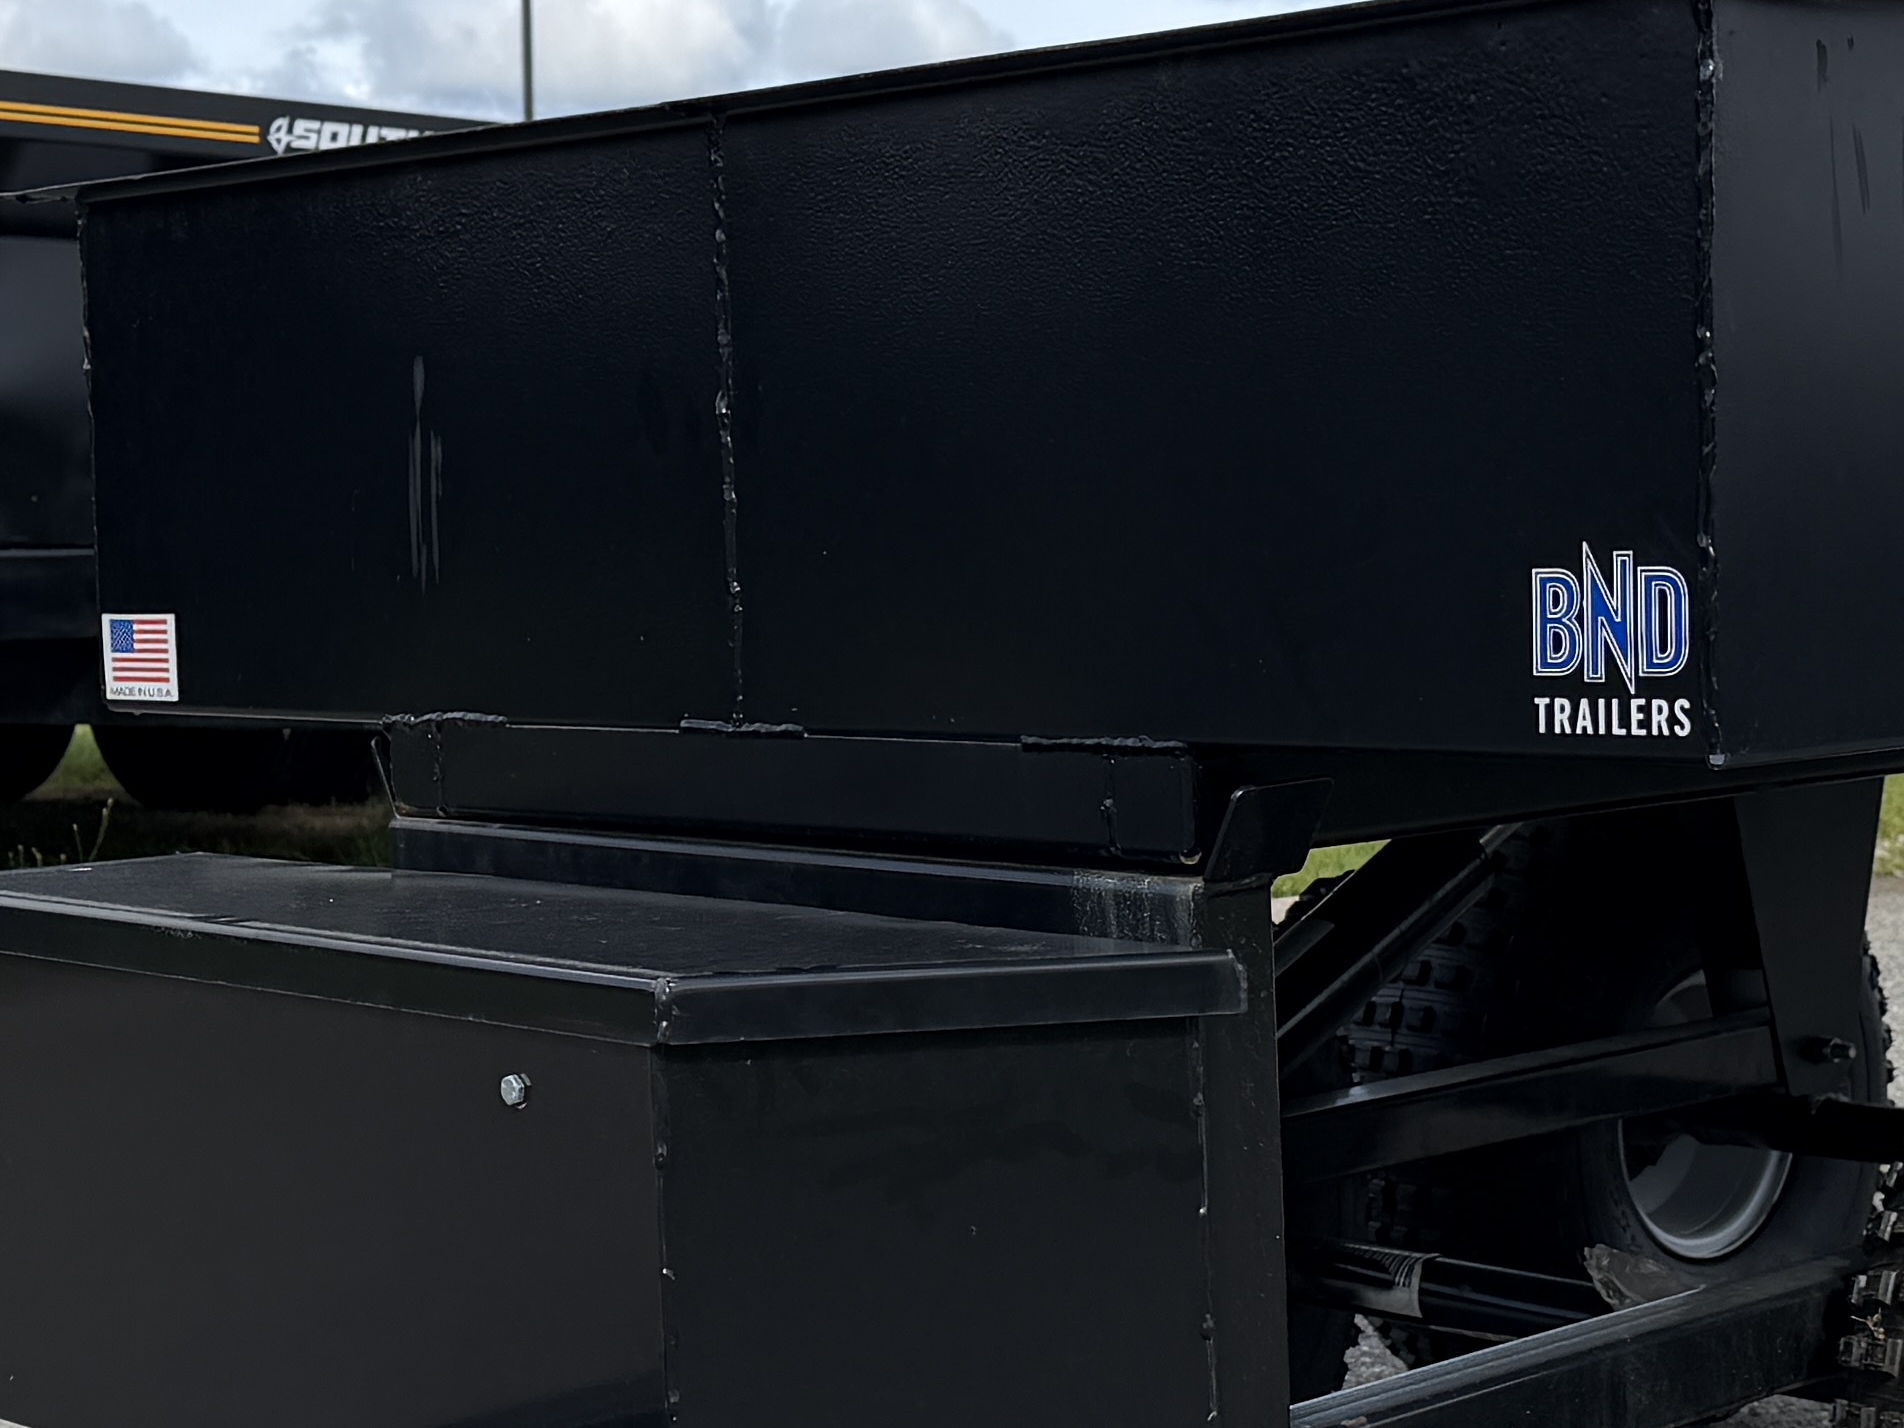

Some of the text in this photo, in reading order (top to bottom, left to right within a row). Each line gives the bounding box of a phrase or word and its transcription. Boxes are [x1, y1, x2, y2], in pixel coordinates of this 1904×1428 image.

[1531, 540, 1690, 695] BND
[109, 686, 136, 697] MADE
[1533, 697, 1692, 737] TRAILERS
